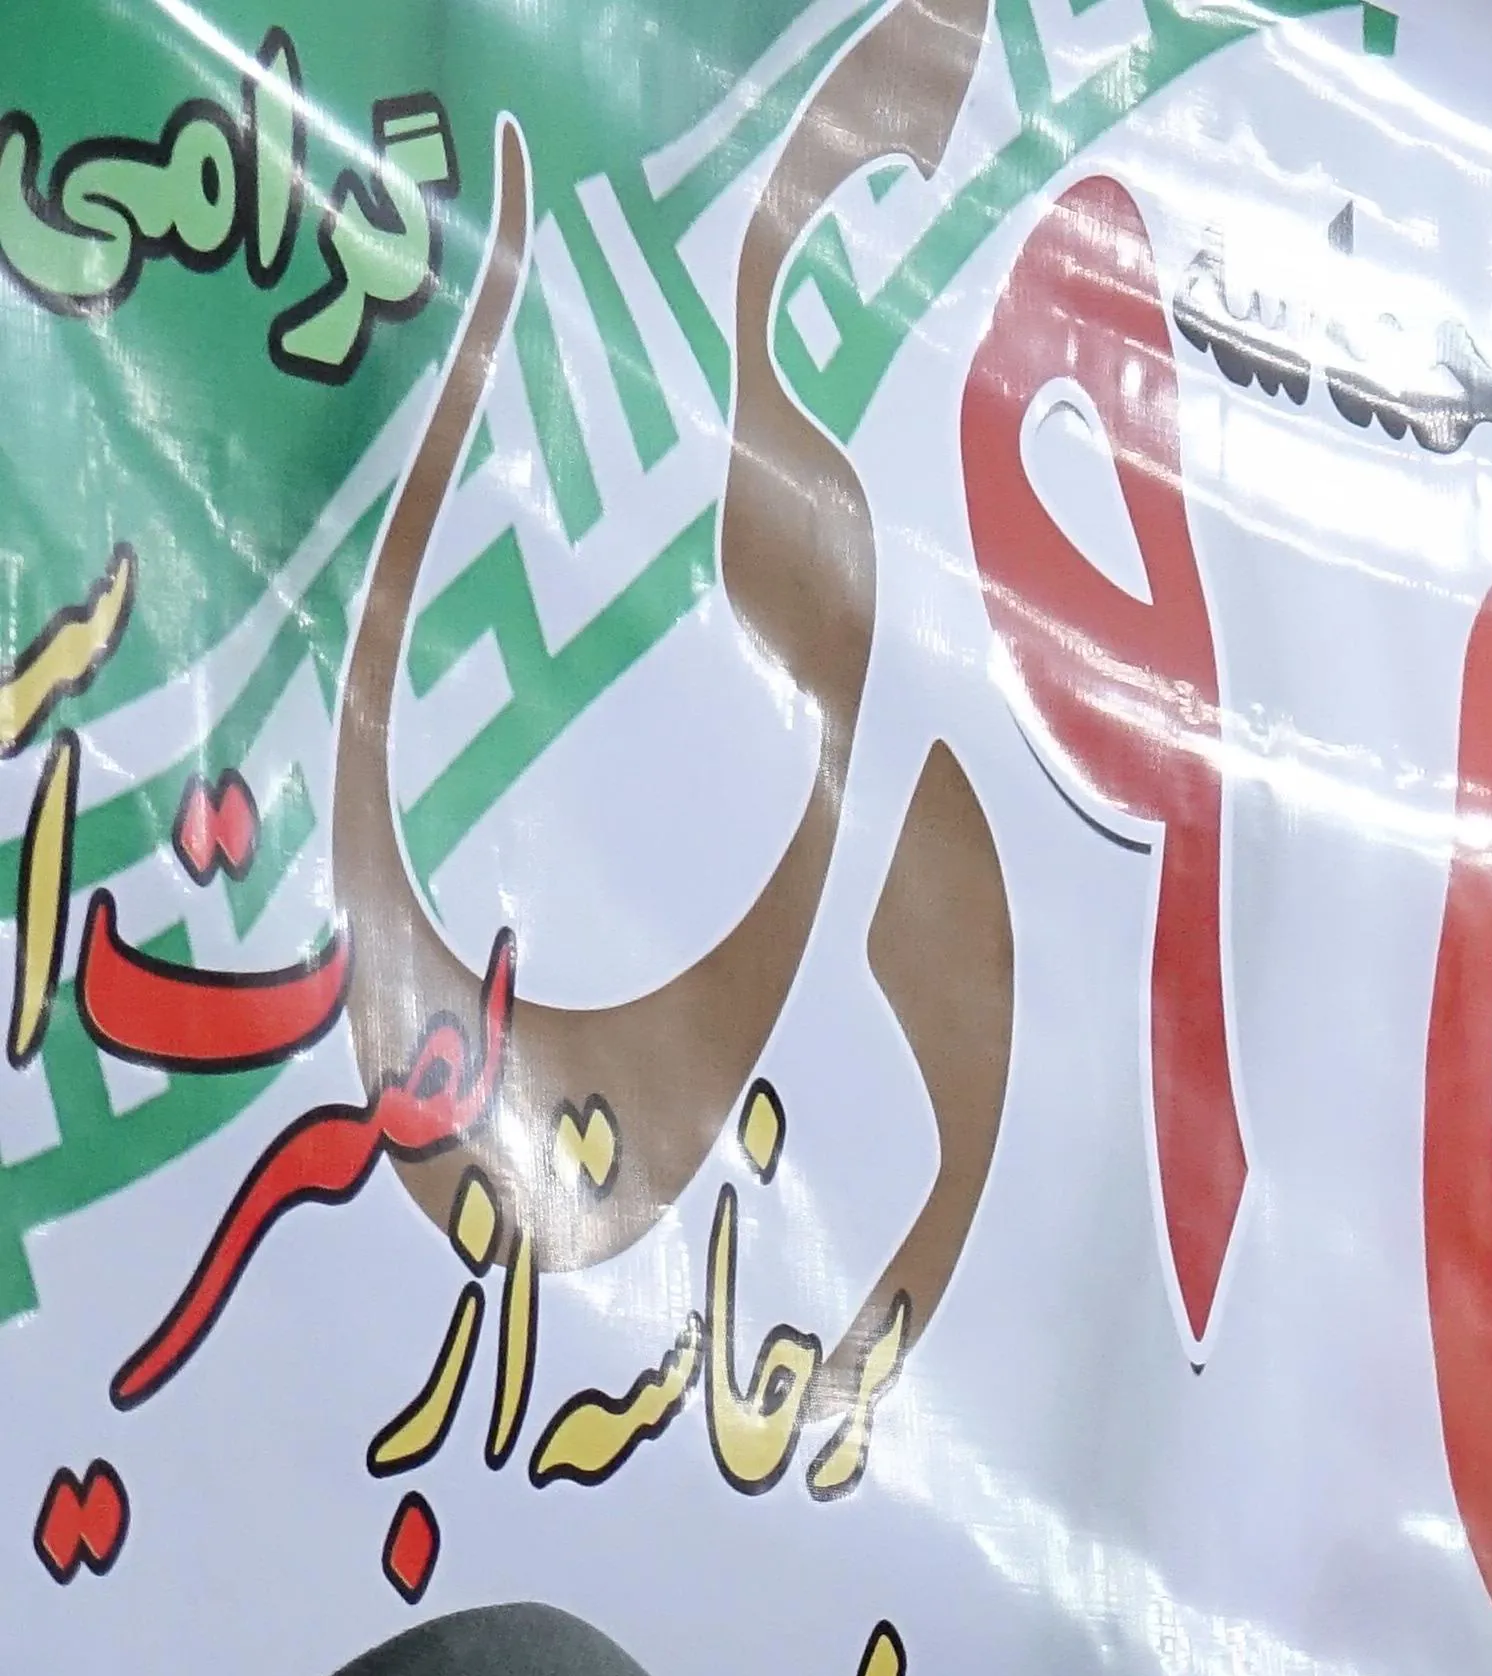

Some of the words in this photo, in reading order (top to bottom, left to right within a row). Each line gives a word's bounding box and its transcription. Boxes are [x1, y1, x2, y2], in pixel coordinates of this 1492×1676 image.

[0, 25, 460, 388] گرامی
[33, 766, 517, 1604] بصیرت
[365, 1163, 542, 1480] از
